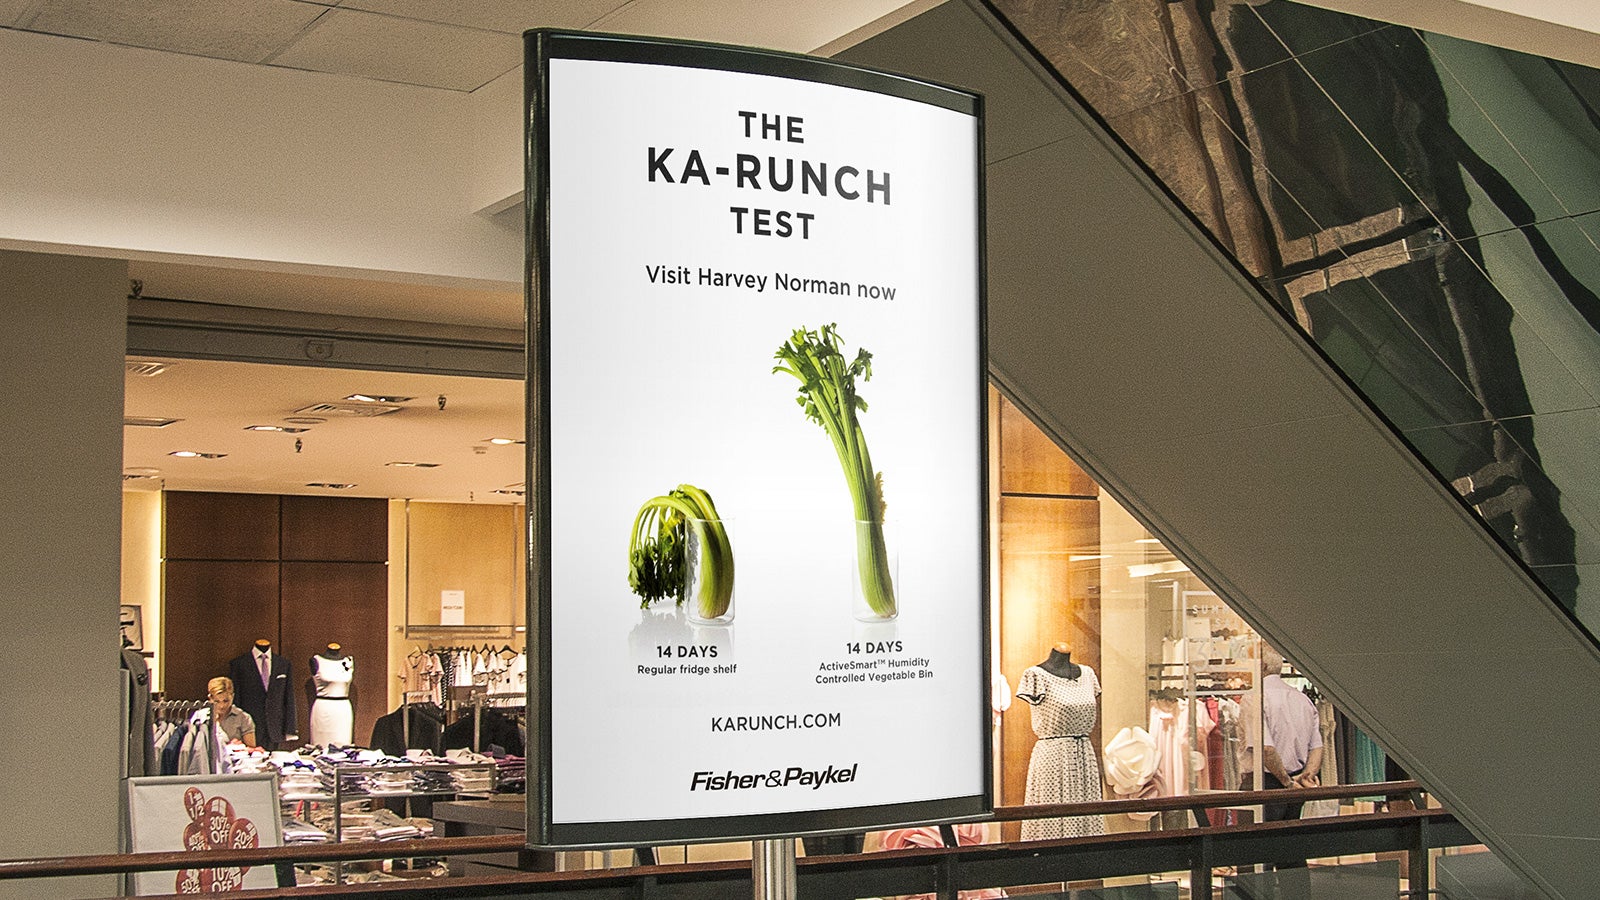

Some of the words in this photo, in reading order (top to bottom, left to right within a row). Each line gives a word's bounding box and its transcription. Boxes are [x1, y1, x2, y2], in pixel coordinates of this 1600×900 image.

[738, 110, 805, 144] THE
[647, 146, 892, 206] KA-RUNCH
[730, 206, 815, 240] TEST
[646, 264, 691, 285] Visit
[698, 267, 768, 293] Harvey
[775, 272, 851, 297] Norman
[857, 284, 897, 302] now
[656, 645, 673, 659] 14
[677, 645, 719, 658] DAYS
[846, 642, 861, 655] 14
[865, 640, 904, 654] DAYS
[637, 664, 677, 676] Regular
[679, 664, 711, 676] fridge
[712, 663, 738, 675] shelf
[888, 657, 931, 669] Humidity
[815, 673, 866, 685] Controlled
[868, 671, 916, 683] Vegetable
[918, 669, 934, 679] Bin
[711, 712, 842, 733] KARUNCH.COM
[690, 762, 859, 791] Fisher&Paykel
[210, 816, 232, 833] 30%
[211, 830, 231, 844] OFF
[211, 867, 234, 882] 10%
